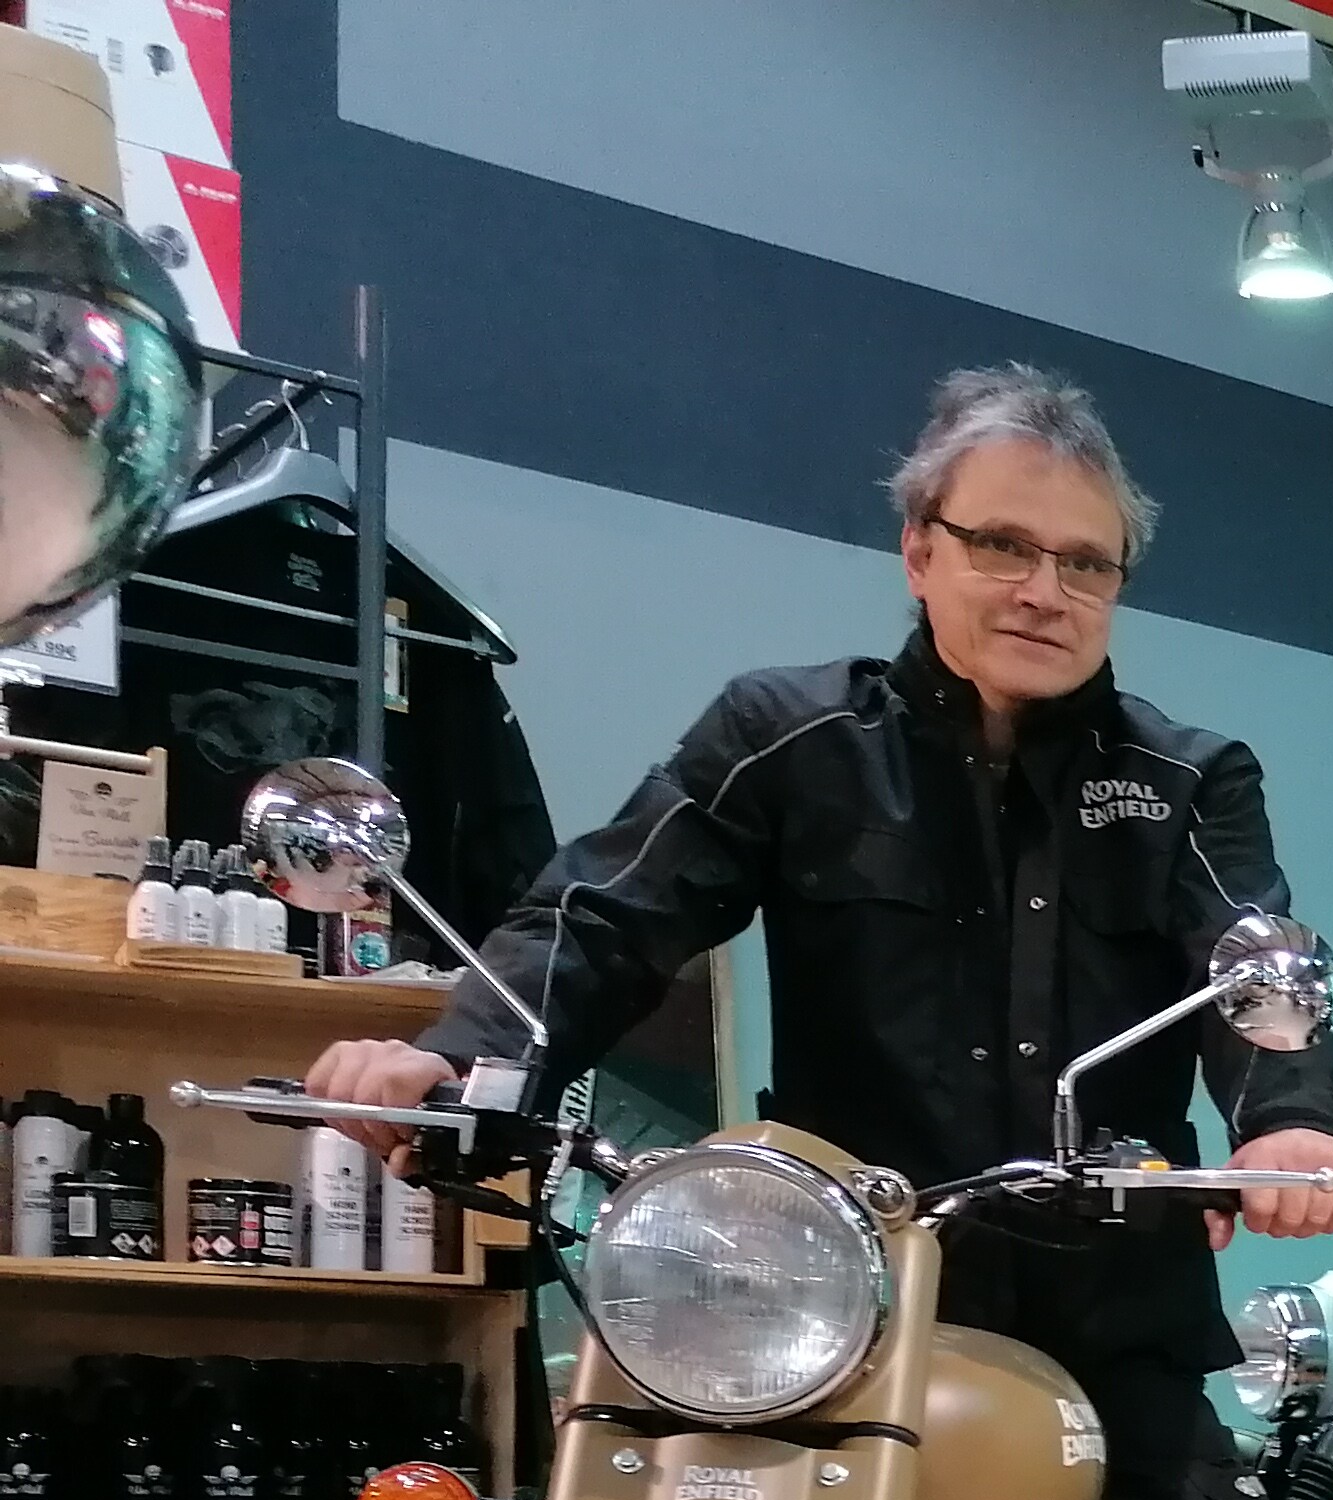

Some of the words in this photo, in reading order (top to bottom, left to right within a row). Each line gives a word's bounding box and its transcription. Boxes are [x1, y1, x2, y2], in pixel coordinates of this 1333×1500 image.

[1081, 779, 1160, 805] ROYAL
[1078, 799, 1173, 829] ENFIELD
[683, 1465, 757, 1485] ROYAL
